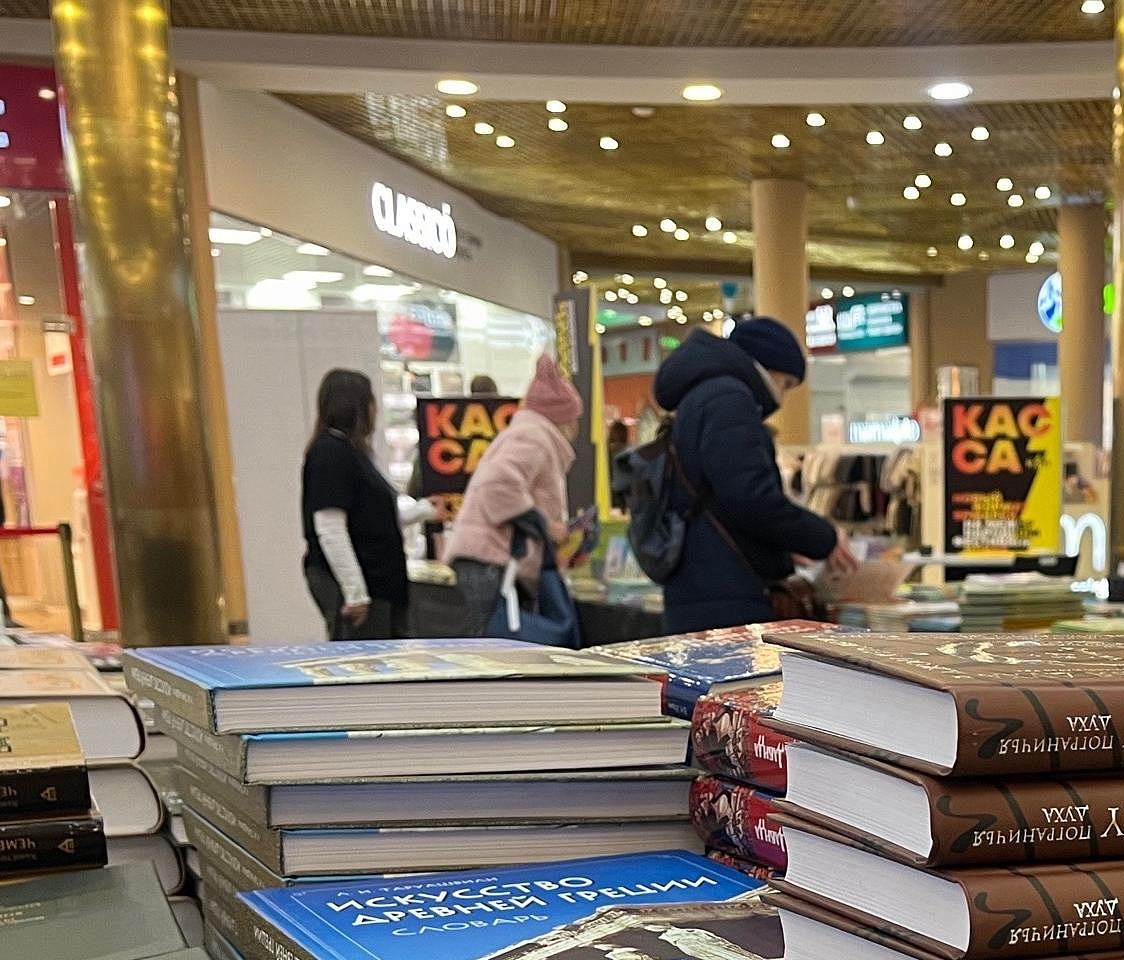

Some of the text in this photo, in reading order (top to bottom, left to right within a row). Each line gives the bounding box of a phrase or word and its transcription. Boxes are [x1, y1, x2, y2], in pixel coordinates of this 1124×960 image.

[952, 403, 1052, 438] КАС
[952, 440, 1024, 474] СА
[1067, 714, 1112, 732] ДУХА
[998, 734, 1114, 754] ПОГРАНИЧЬЯ
[1042, 805, 1089, 823] ДУХА
[973, 824, 1092, 846] ПОГРАНИЧЬЯ
[327, 876, 595, 912] ИСКУССТВО
[352, 875, 719, 926] ДРЕВНЕЙ ГРЕЦИИ
[1074, 898, 1119, 918] ДУХА
[392, 912, 549, 936] СЛОВАРЬ
[1009, 917, 1122, 944] ПОГРАНИЧЬЯ
